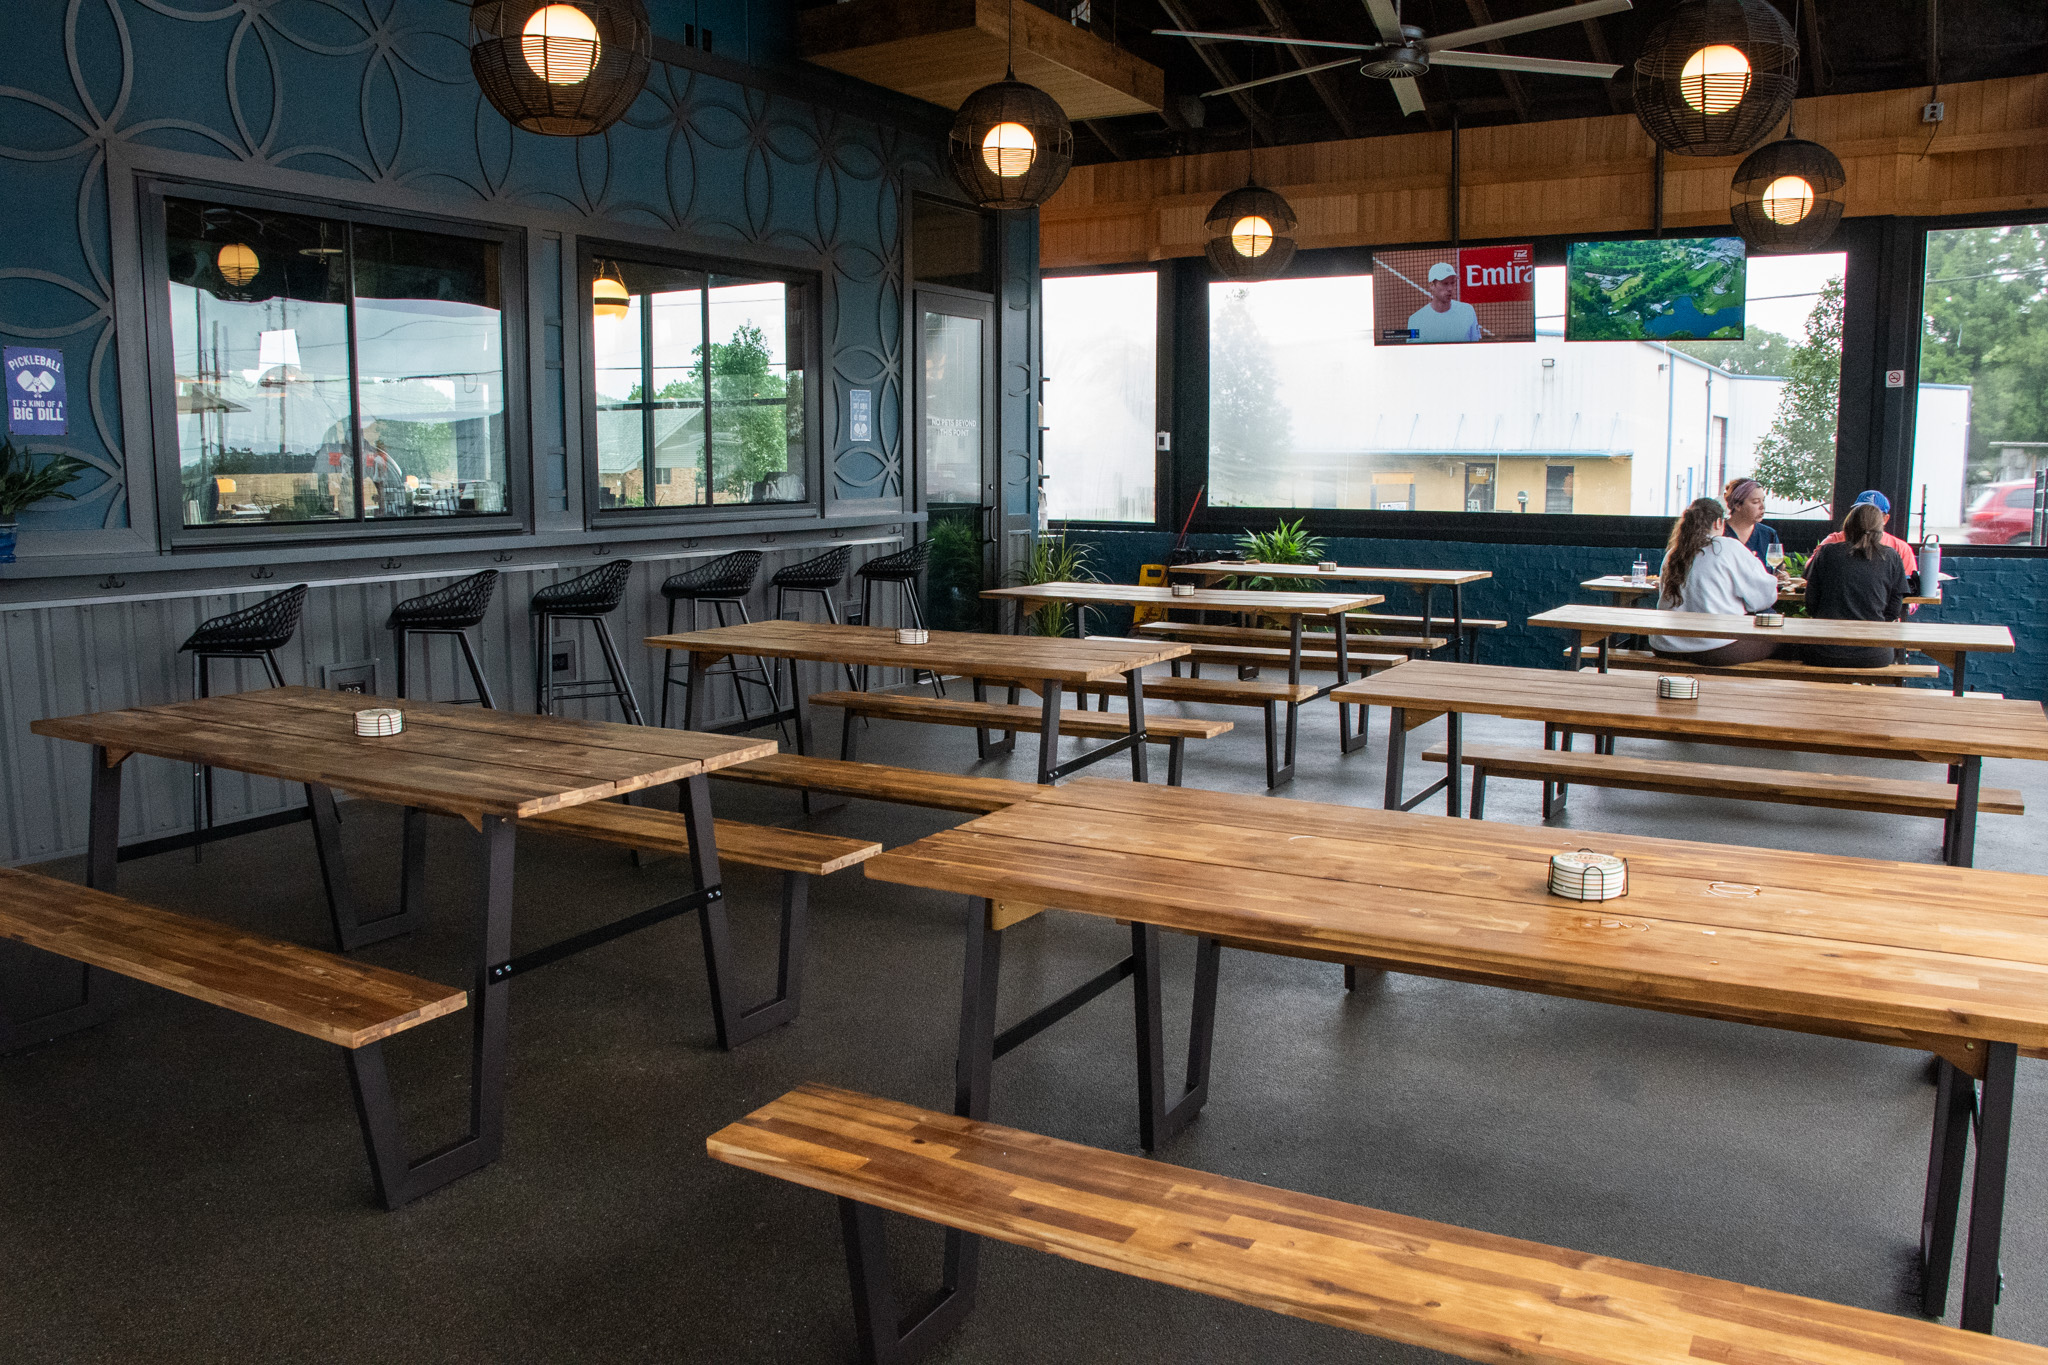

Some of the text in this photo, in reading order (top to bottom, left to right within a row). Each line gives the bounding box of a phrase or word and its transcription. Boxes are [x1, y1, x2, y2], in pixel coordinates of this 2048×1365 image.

[1465, 261, 1533, 287] Emira
[8, 354, 61, 373] PICKLEBALL
[12, 399, 27, 407] IT'S
[28, 400, 46, 408] KIND
[47, 400, 56, 408] OF
[13, 407, 64, 421] BIG DILL
